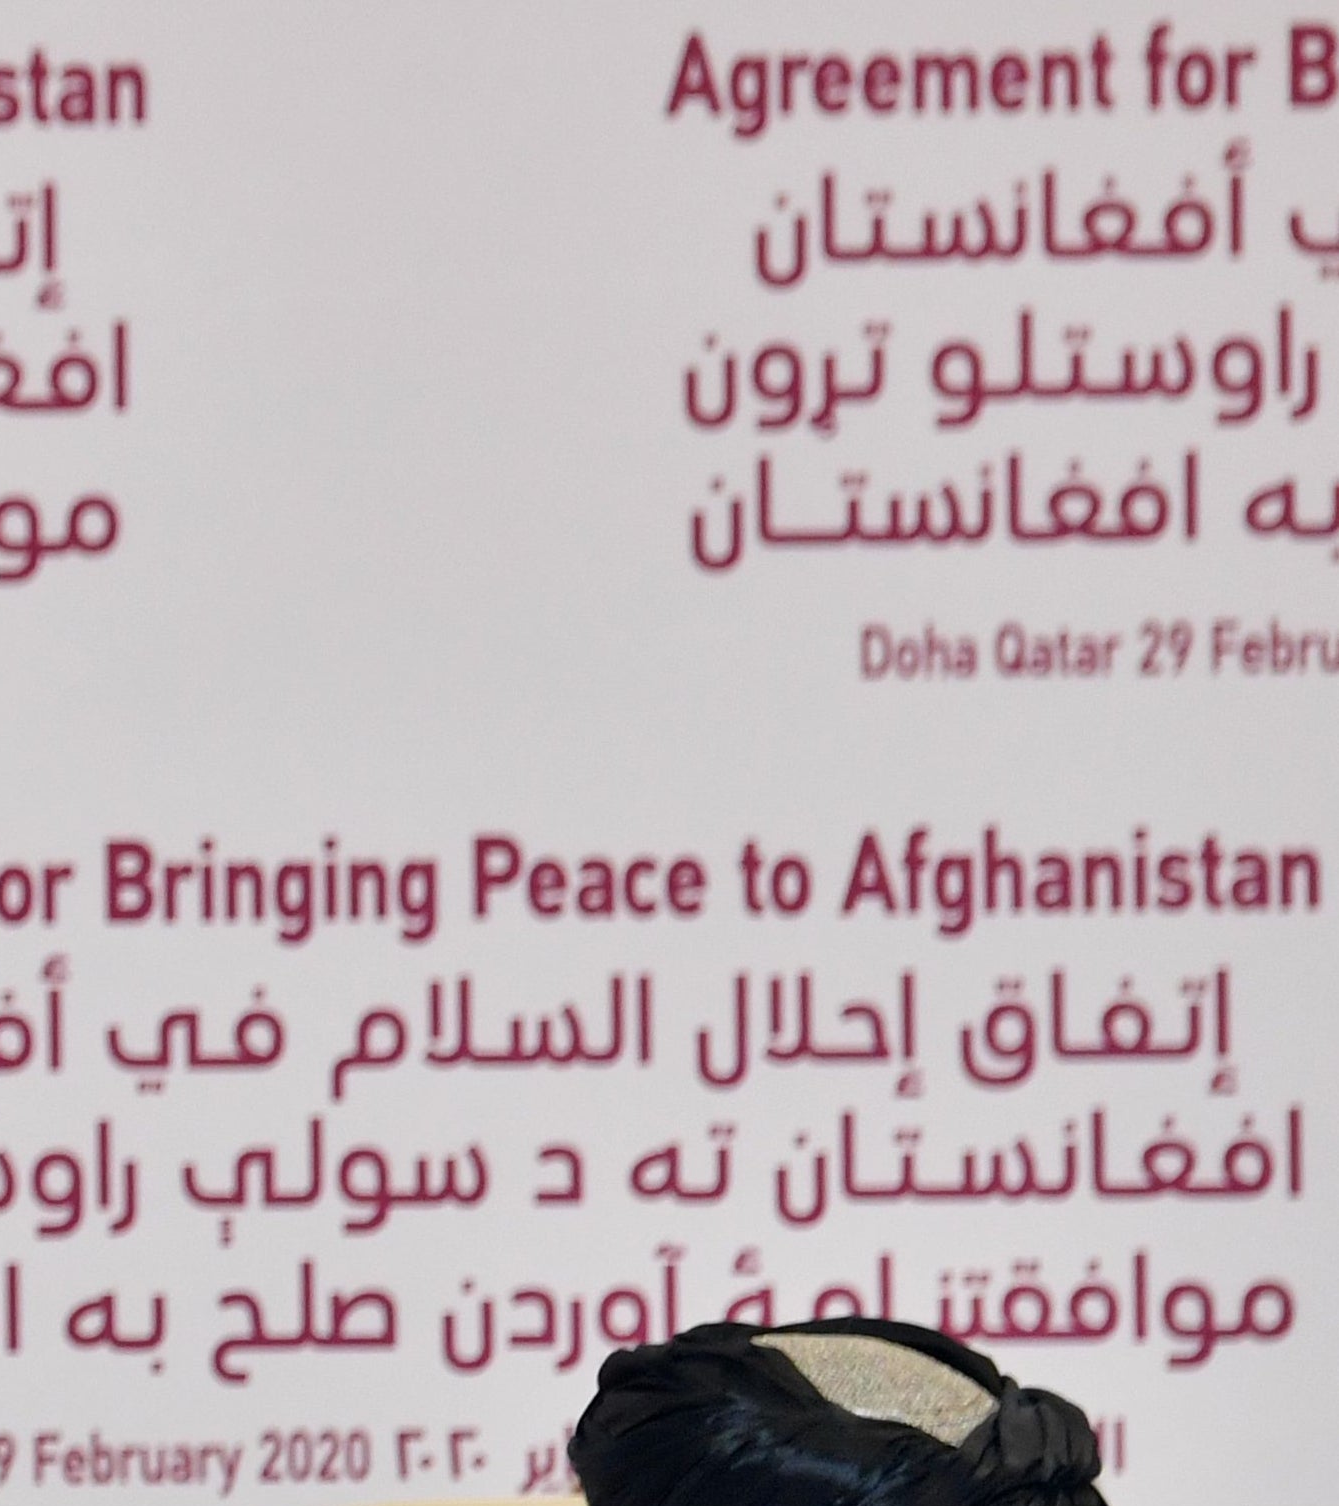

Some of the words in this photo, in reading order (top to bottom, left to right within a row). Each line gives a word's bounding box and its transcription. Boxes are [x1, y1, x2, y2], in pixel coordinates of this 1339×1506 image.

[667, 33, 1117, 142] Agreement
[1145, 21, 1258, 112] for
[753, 136, 1252, 289] أفغانستان
[930, 303, 1321, 430] راوستلو
[691, 445, 1200, 574] افغانستان
[861, 623, 978, 678] Doha
[995, 623, 1120, 676] Qatar
[1141, 620, 1194, 673] 29
[1213, 620, 1339, 672] Febru
[105, 834, 441, 947] Bringing
[473, 832, 709, 920] Peace
[741, 840, 814, 916] to
[842, 825, 1322, 940] Afghanistan
[107, 987, 287, 1092] في
[331, 972, 653, 1101] السلام
[696, 970, 921, 1097] إحلال
[960, 965, 1234, 1093] إتفاق
[537, 1143, 586, 1205] د
[629, 1124, 736, 1204] ته
[775, 1106, 1304, 1229] افغانستان
[65, 1293, 168, 1372] به
[212, 1259, 400, 1383] صلح
[34, 1432, 243, 1490] February
[261, 1429, 371, 1483] 2020
